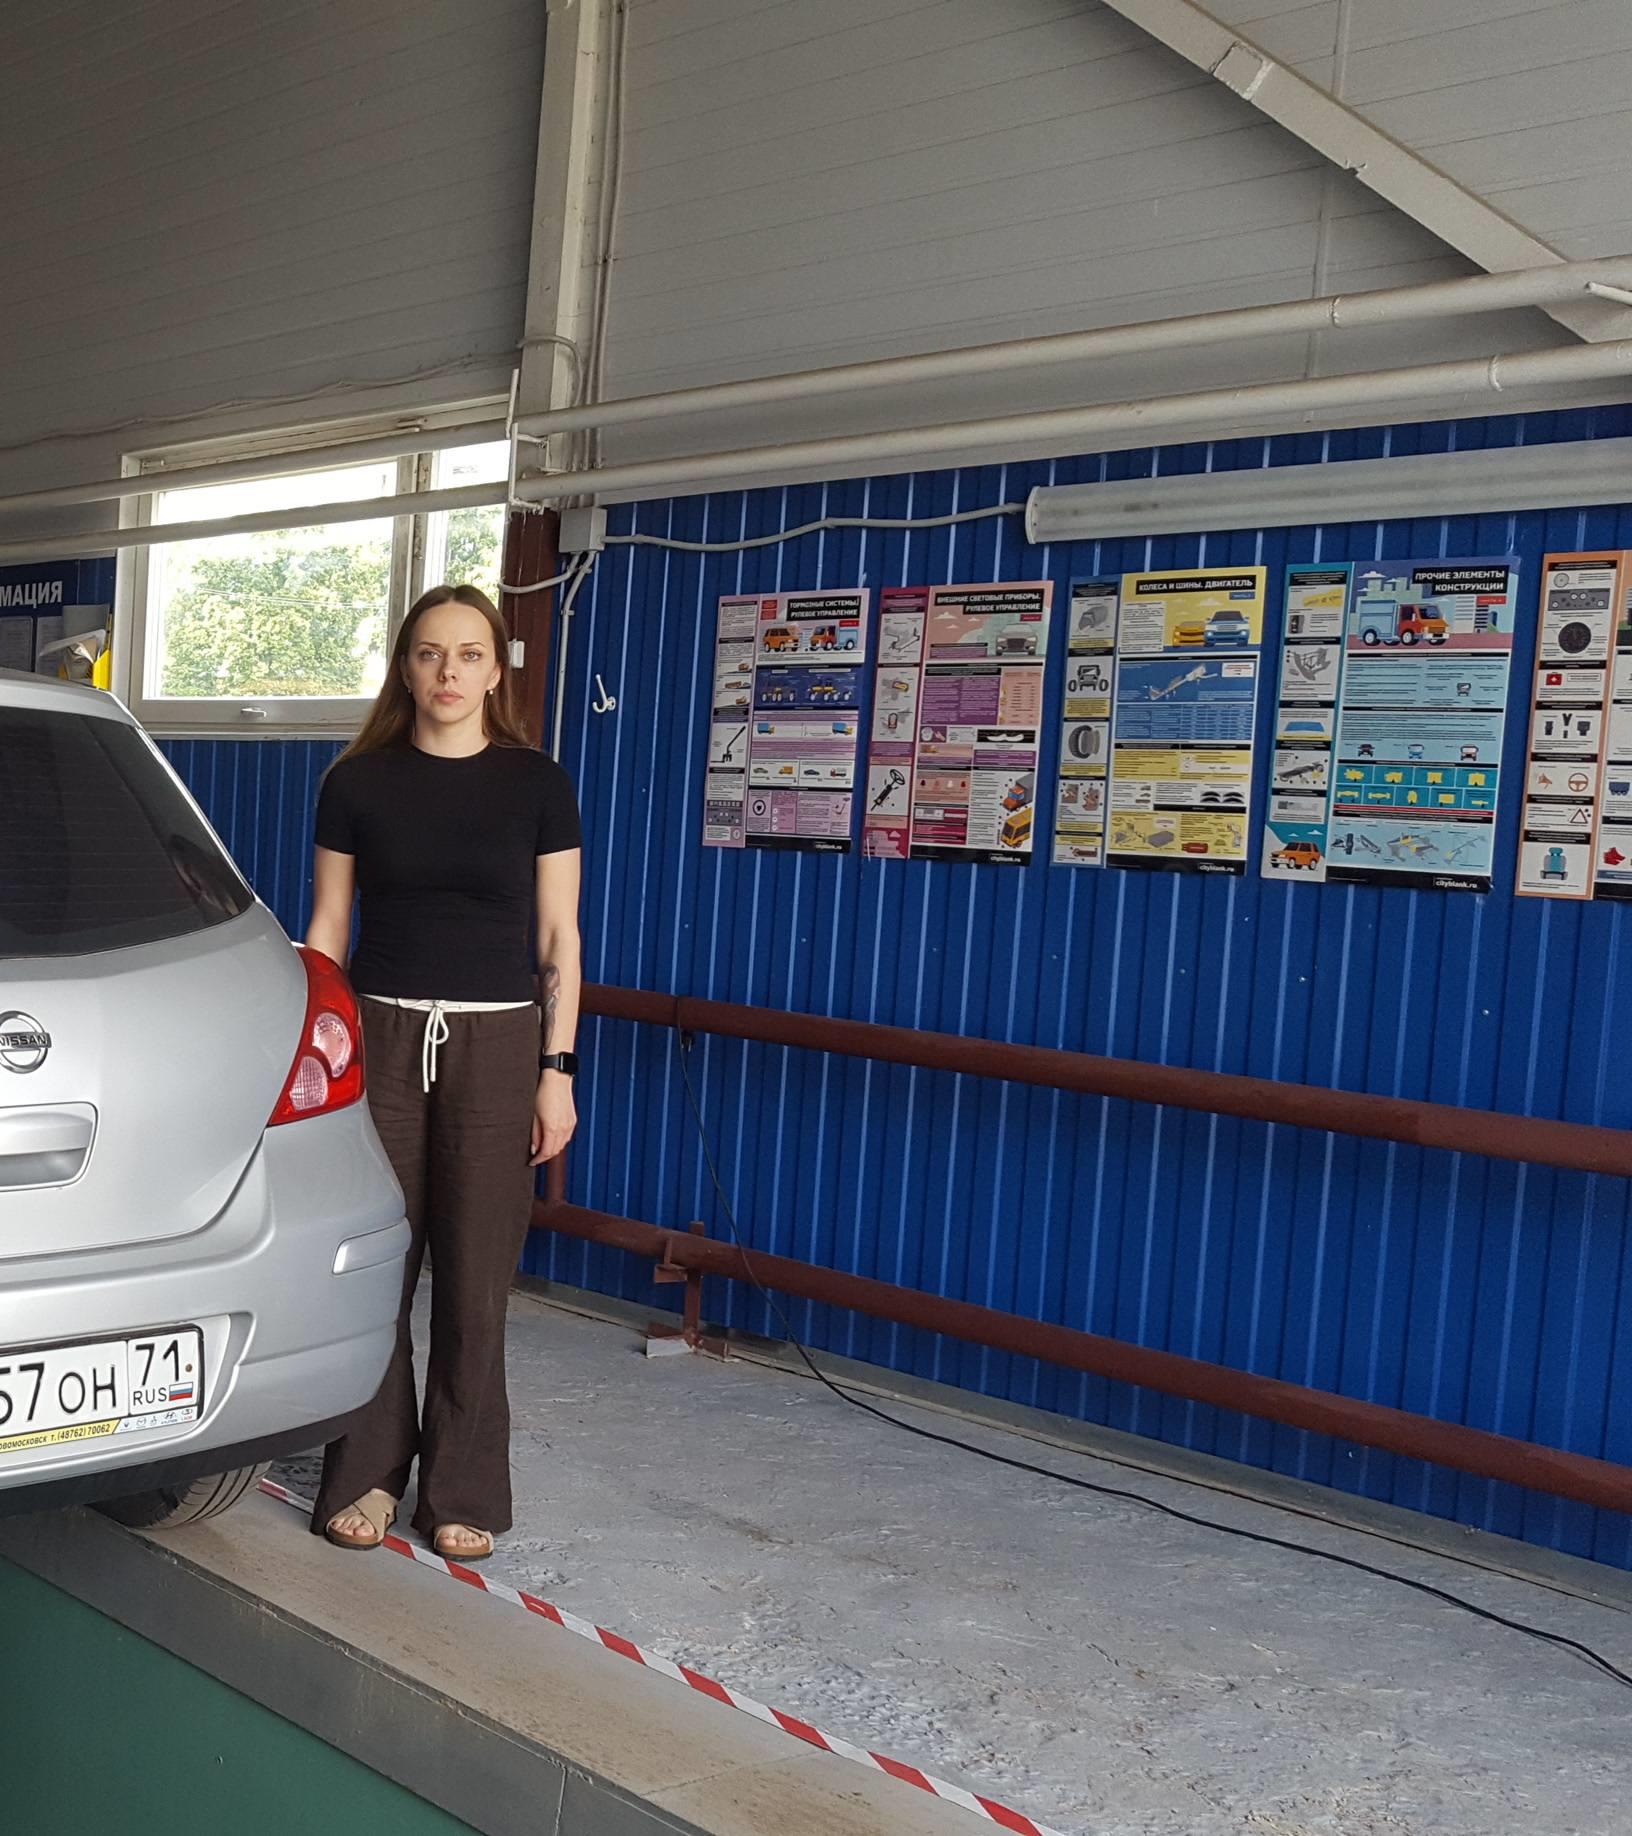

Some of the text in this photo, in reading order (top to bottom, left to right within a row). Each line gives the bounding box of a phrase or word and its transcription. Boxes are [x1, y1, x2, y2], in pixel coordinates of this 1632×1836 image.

[1415, 570, 1505, 580] ПРОЧИЕ ЭЛЕМЕНТЫ
[1139, 583, 1168, 591] КОЛЕСА
[1204, 579, 1253, 589] ДВИГАТЕЛЬ
[1435, 583, 1504, 591] КОНСТРУКЦИИ
[970, 593, 1003, 602] СВЕТОВЫЕ
[965, 603, 1041, 612] РУЛЕВОЕ УПРАВЛЕНИЕ
[816, 609, 858, 617] УПРАВЛЕНИЕ
[135, 1339, 180, 1387] 71
[133, 1386, 168, 1406] RUS
